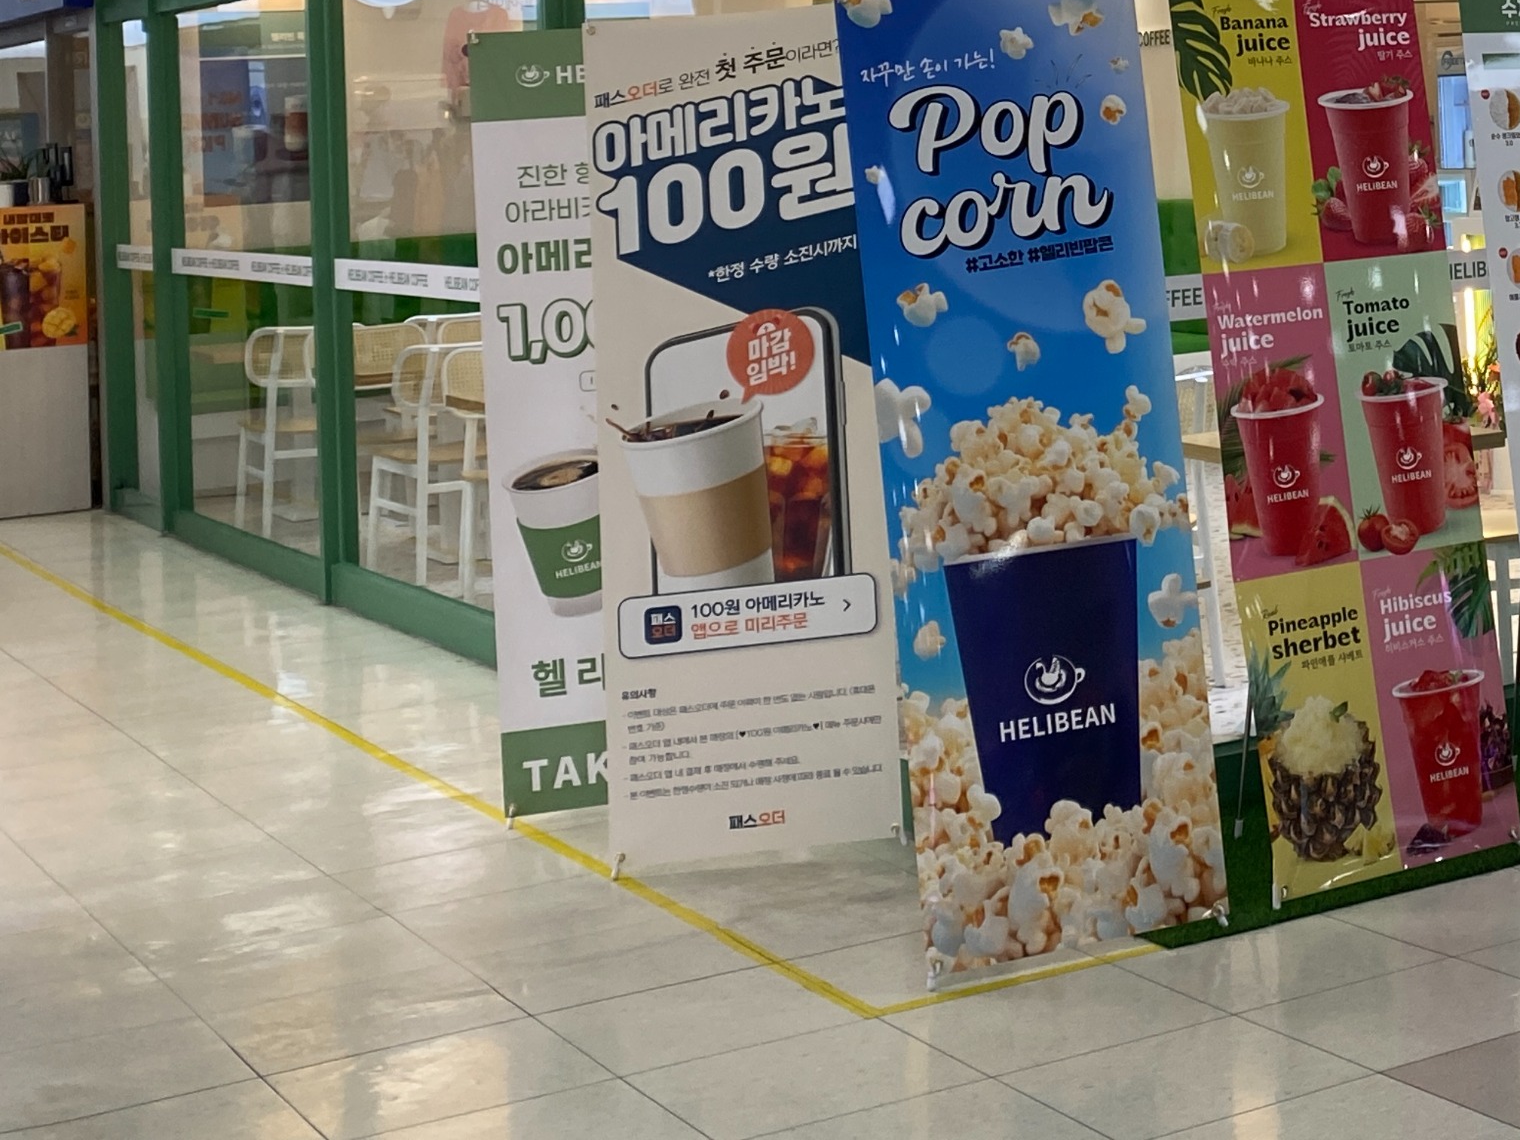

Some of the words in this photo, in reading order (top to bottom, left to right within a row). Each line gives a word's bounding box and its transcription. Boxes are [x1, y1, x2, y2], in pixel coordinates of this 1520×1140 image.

[1220, 16, 1288, 31] Banana
[1309, 11, 1408, 28] Strawberry
[1236, 33, 1291, 57] juice
[1358, 28, 1411, 51] juice
[1275, 56, 1293, 66] 주스
[1396, 49, 1413, 59] 주스
[594, 77, 674, 108] 패스오더로
[678, 69, 711, 91] 완전
[715, 56, 737, 82] 첫
[743, 38, 841, 74] 주문이라면?
[861, 60, 914, 87] 자꾸만
[919, 57, 948, 79] 손이
[953, 48, 997, 71] 가는!
[593, 75, 846, 174] 아메리카노
[888, 84, 1084, 175] Pop
[517, 163, 567, 189] 진한
[1356, 180, 1398, 193] HELIBEAN
[596, 123, 856, 256] 100원
[900, 172, 1114, 258] corn
[750, 254, 779, 272] 수량
[783, 233, 858, 266] 소진시까지
[965, 250, 1024, 273] #고소한
[1217, 306, 1323, 330] Watermelon
[1342, 297, 1410, 316] Tomato
[497, 298, 595, 364] 1,0
[1346, 317, 1400, 343] juice
[748, 331, 791, 361] 마감
[1220, 332, 1274, 359] juice
[1347, 340, 1373, 353] 토마토
[1375, 339, 1393, 350] 주스
[747, 351, 797, 386] 임박!
[1391, 469, 1432, 484] HELIBEAN
[1267, 489, 1309, 504] HELIBEAN
[691, 598, 741, 619] 100원
[745, 591, 825, 614] 아메리카노
[1379, 590, 1453, 615] Hibiscus
[691, 620, 739, 640] 앱으로
[745, 612, 808, 634] 미리주문
[1267, 606, 1359, 637] Pineapple
[1383, 612, 1437, 643] juice
[1272, 626, 1362, 660] sherbet
[1427, 634, 1445, 647] 주스
[1301, 654, 1336, 671] 파인애플
[621, 688, 657, 700] 유의사항
[1000, 703, 1117, 743] HELIBEAN
[1429, 766, 1470, 783] HELIBEAN
[729, 810, 786, 830] 패스오더
